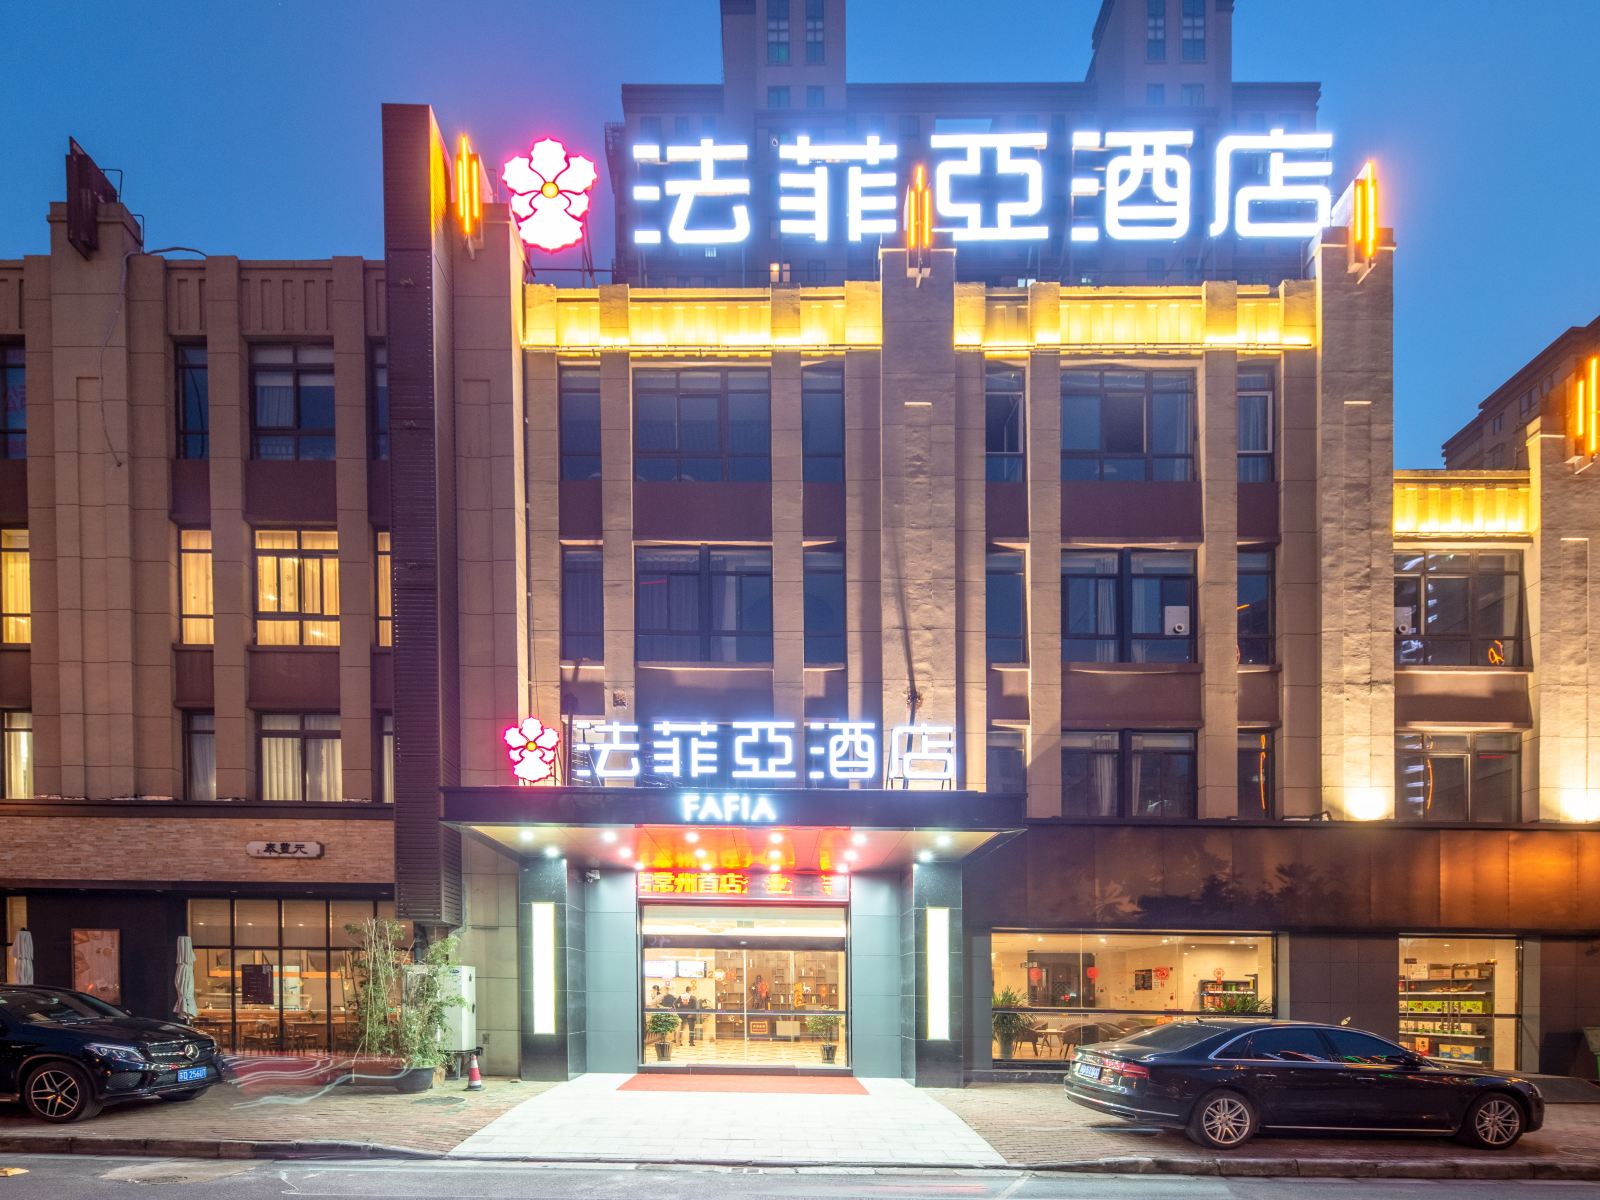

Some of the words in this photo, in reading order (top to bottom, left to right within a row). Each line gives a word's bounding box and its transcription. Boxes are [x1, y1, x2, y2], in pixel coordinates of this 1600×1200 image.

[632, 128, 1334, 245] 法菲亞酒店
[573, 721, 956, 780] 法菲亞酒店
[682, 795, 777, 821] FAFIA
[639, 872, 749, 894] 常州首店
